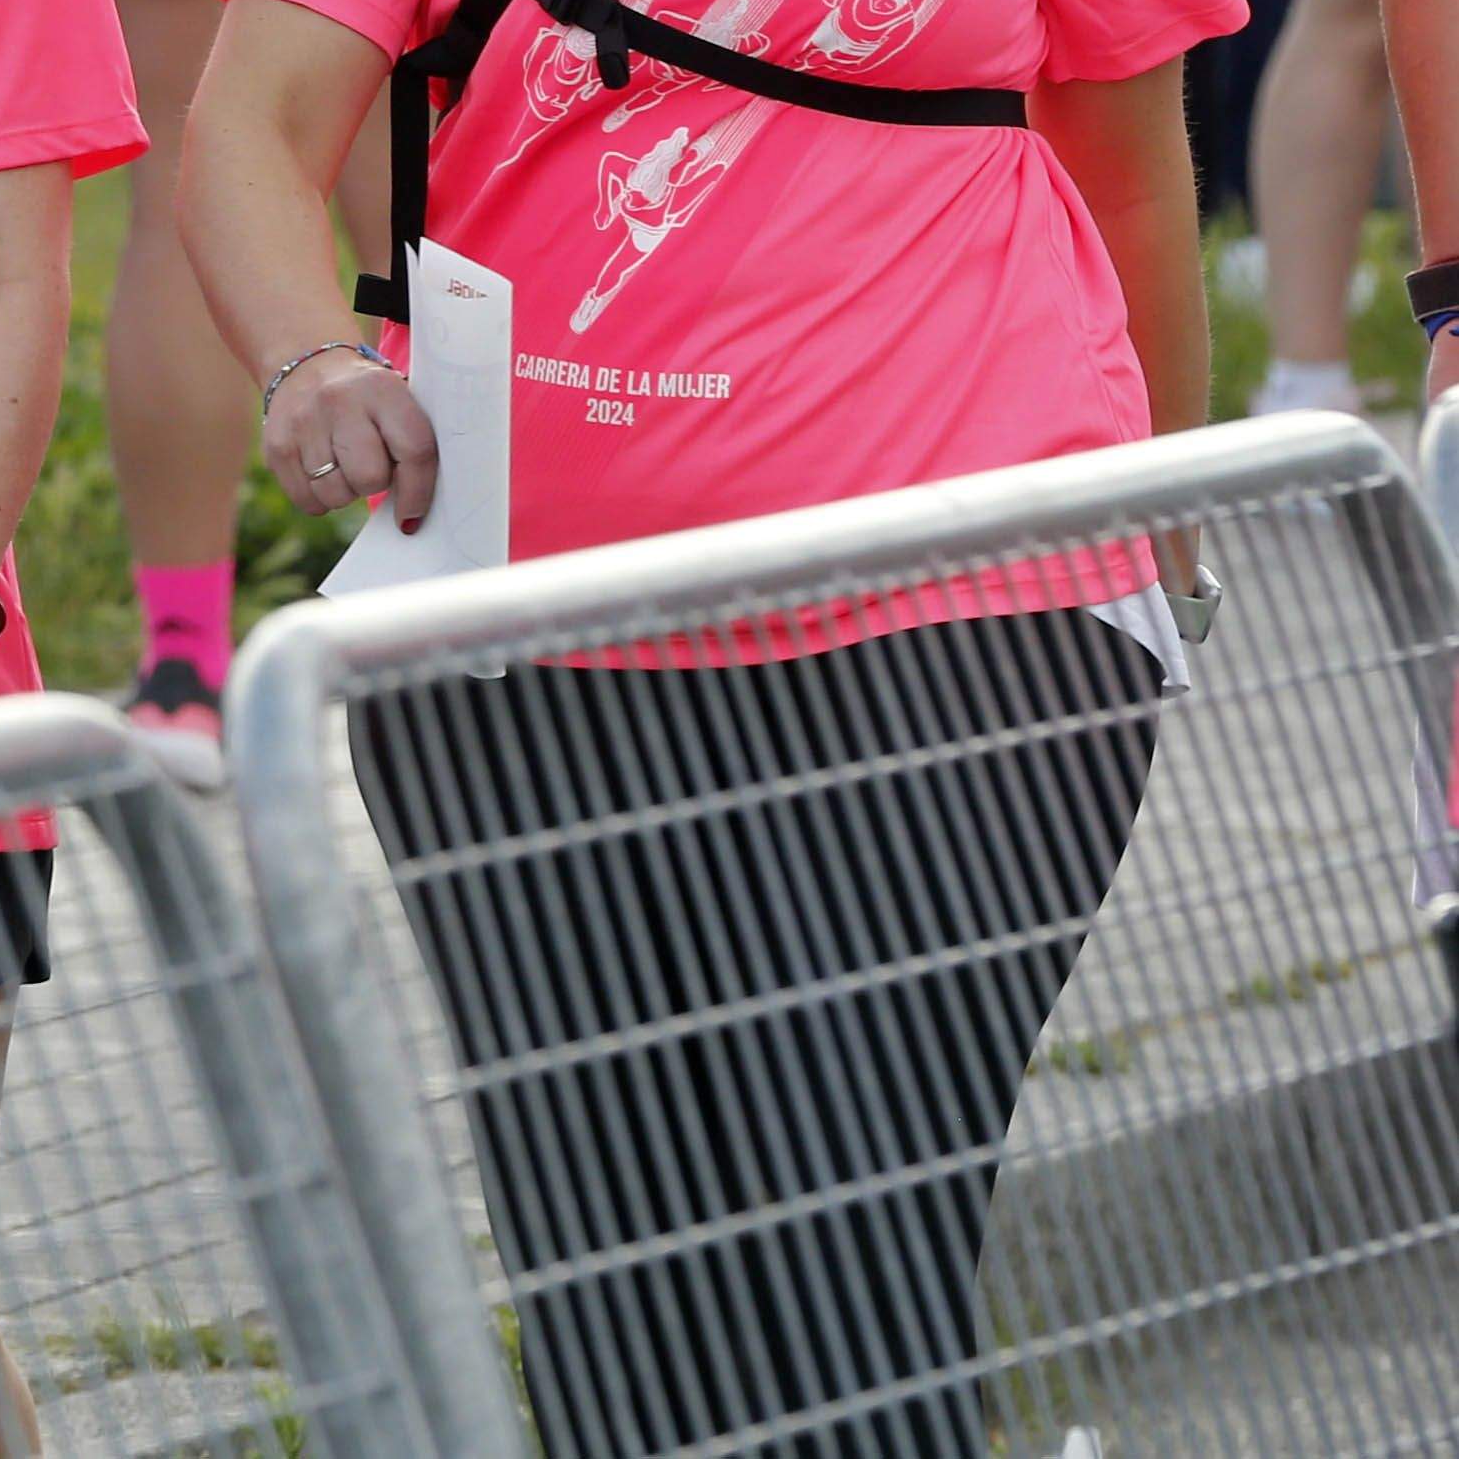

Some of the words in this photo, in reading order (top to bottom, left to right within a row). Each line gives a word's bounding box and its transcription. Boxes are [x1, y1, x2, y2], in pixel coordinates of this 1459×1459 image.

[515, 352, 590, 390] CARRERA
[595, 366, 621, 393] DE
[627, 370, 651, 397] LA
[657, 372, 731, 399] MUJER
[585, 398, 635, 426] 2024
